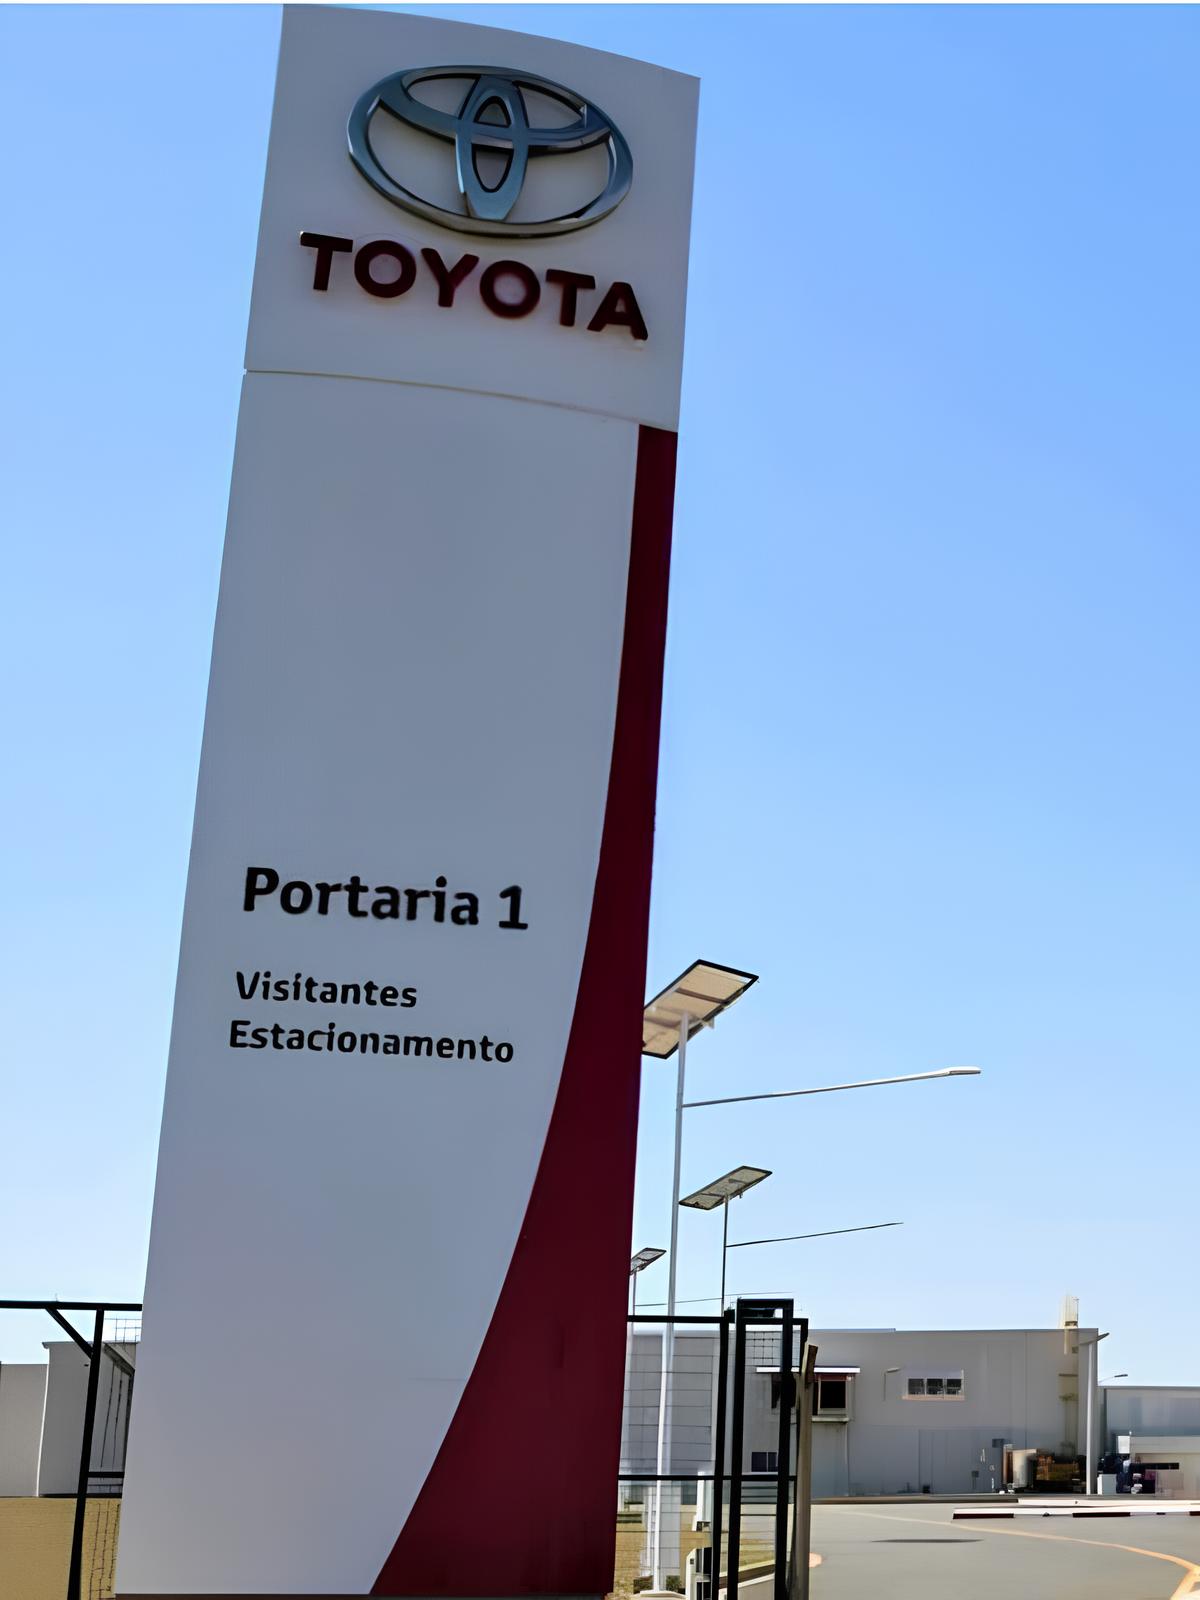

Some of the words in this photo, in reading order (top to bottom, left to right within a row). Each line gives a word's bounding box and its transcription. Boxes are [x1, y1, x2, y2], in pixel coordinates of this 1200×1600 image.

[300, 231, 648, 341] TOYOTA
[243, 866, 479, 926] Portaria
[498, 885, 529, 931] 1
[236, 970, 417, 1008] Visitantes
[229, 1019, 514, 1063] Estacionamento
